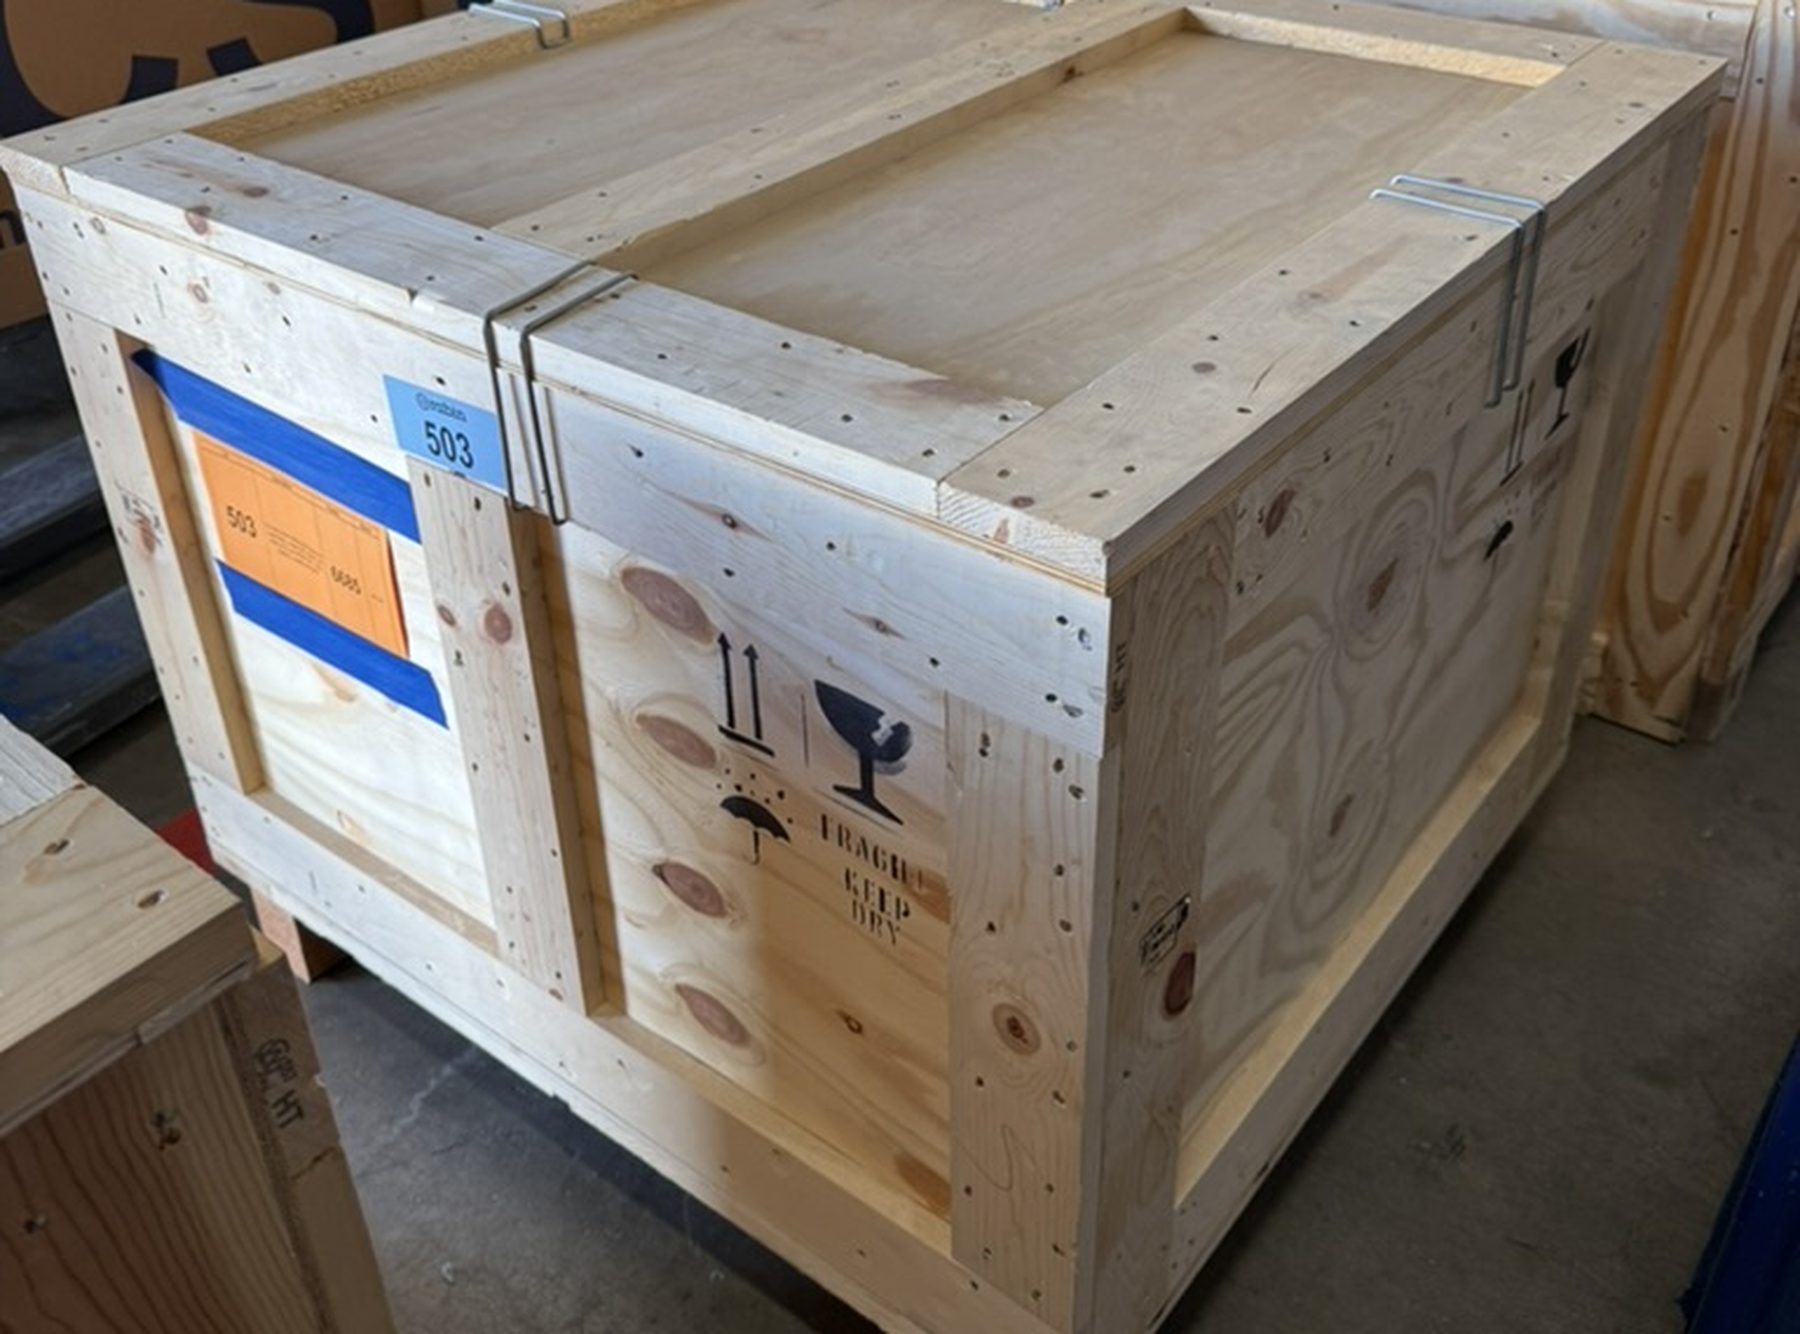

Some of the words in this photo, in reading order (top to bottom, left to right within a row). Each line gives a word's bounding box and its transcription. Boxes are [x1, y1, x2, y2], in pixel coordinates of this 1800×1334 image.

[424, 419, 475, 469] 503
[226, 504, 257, 539] 503
[845, 867, 911, 920] KEEP
[852, 897, 902, 946] DRY
[271, 1088, 306, 1130] HT
